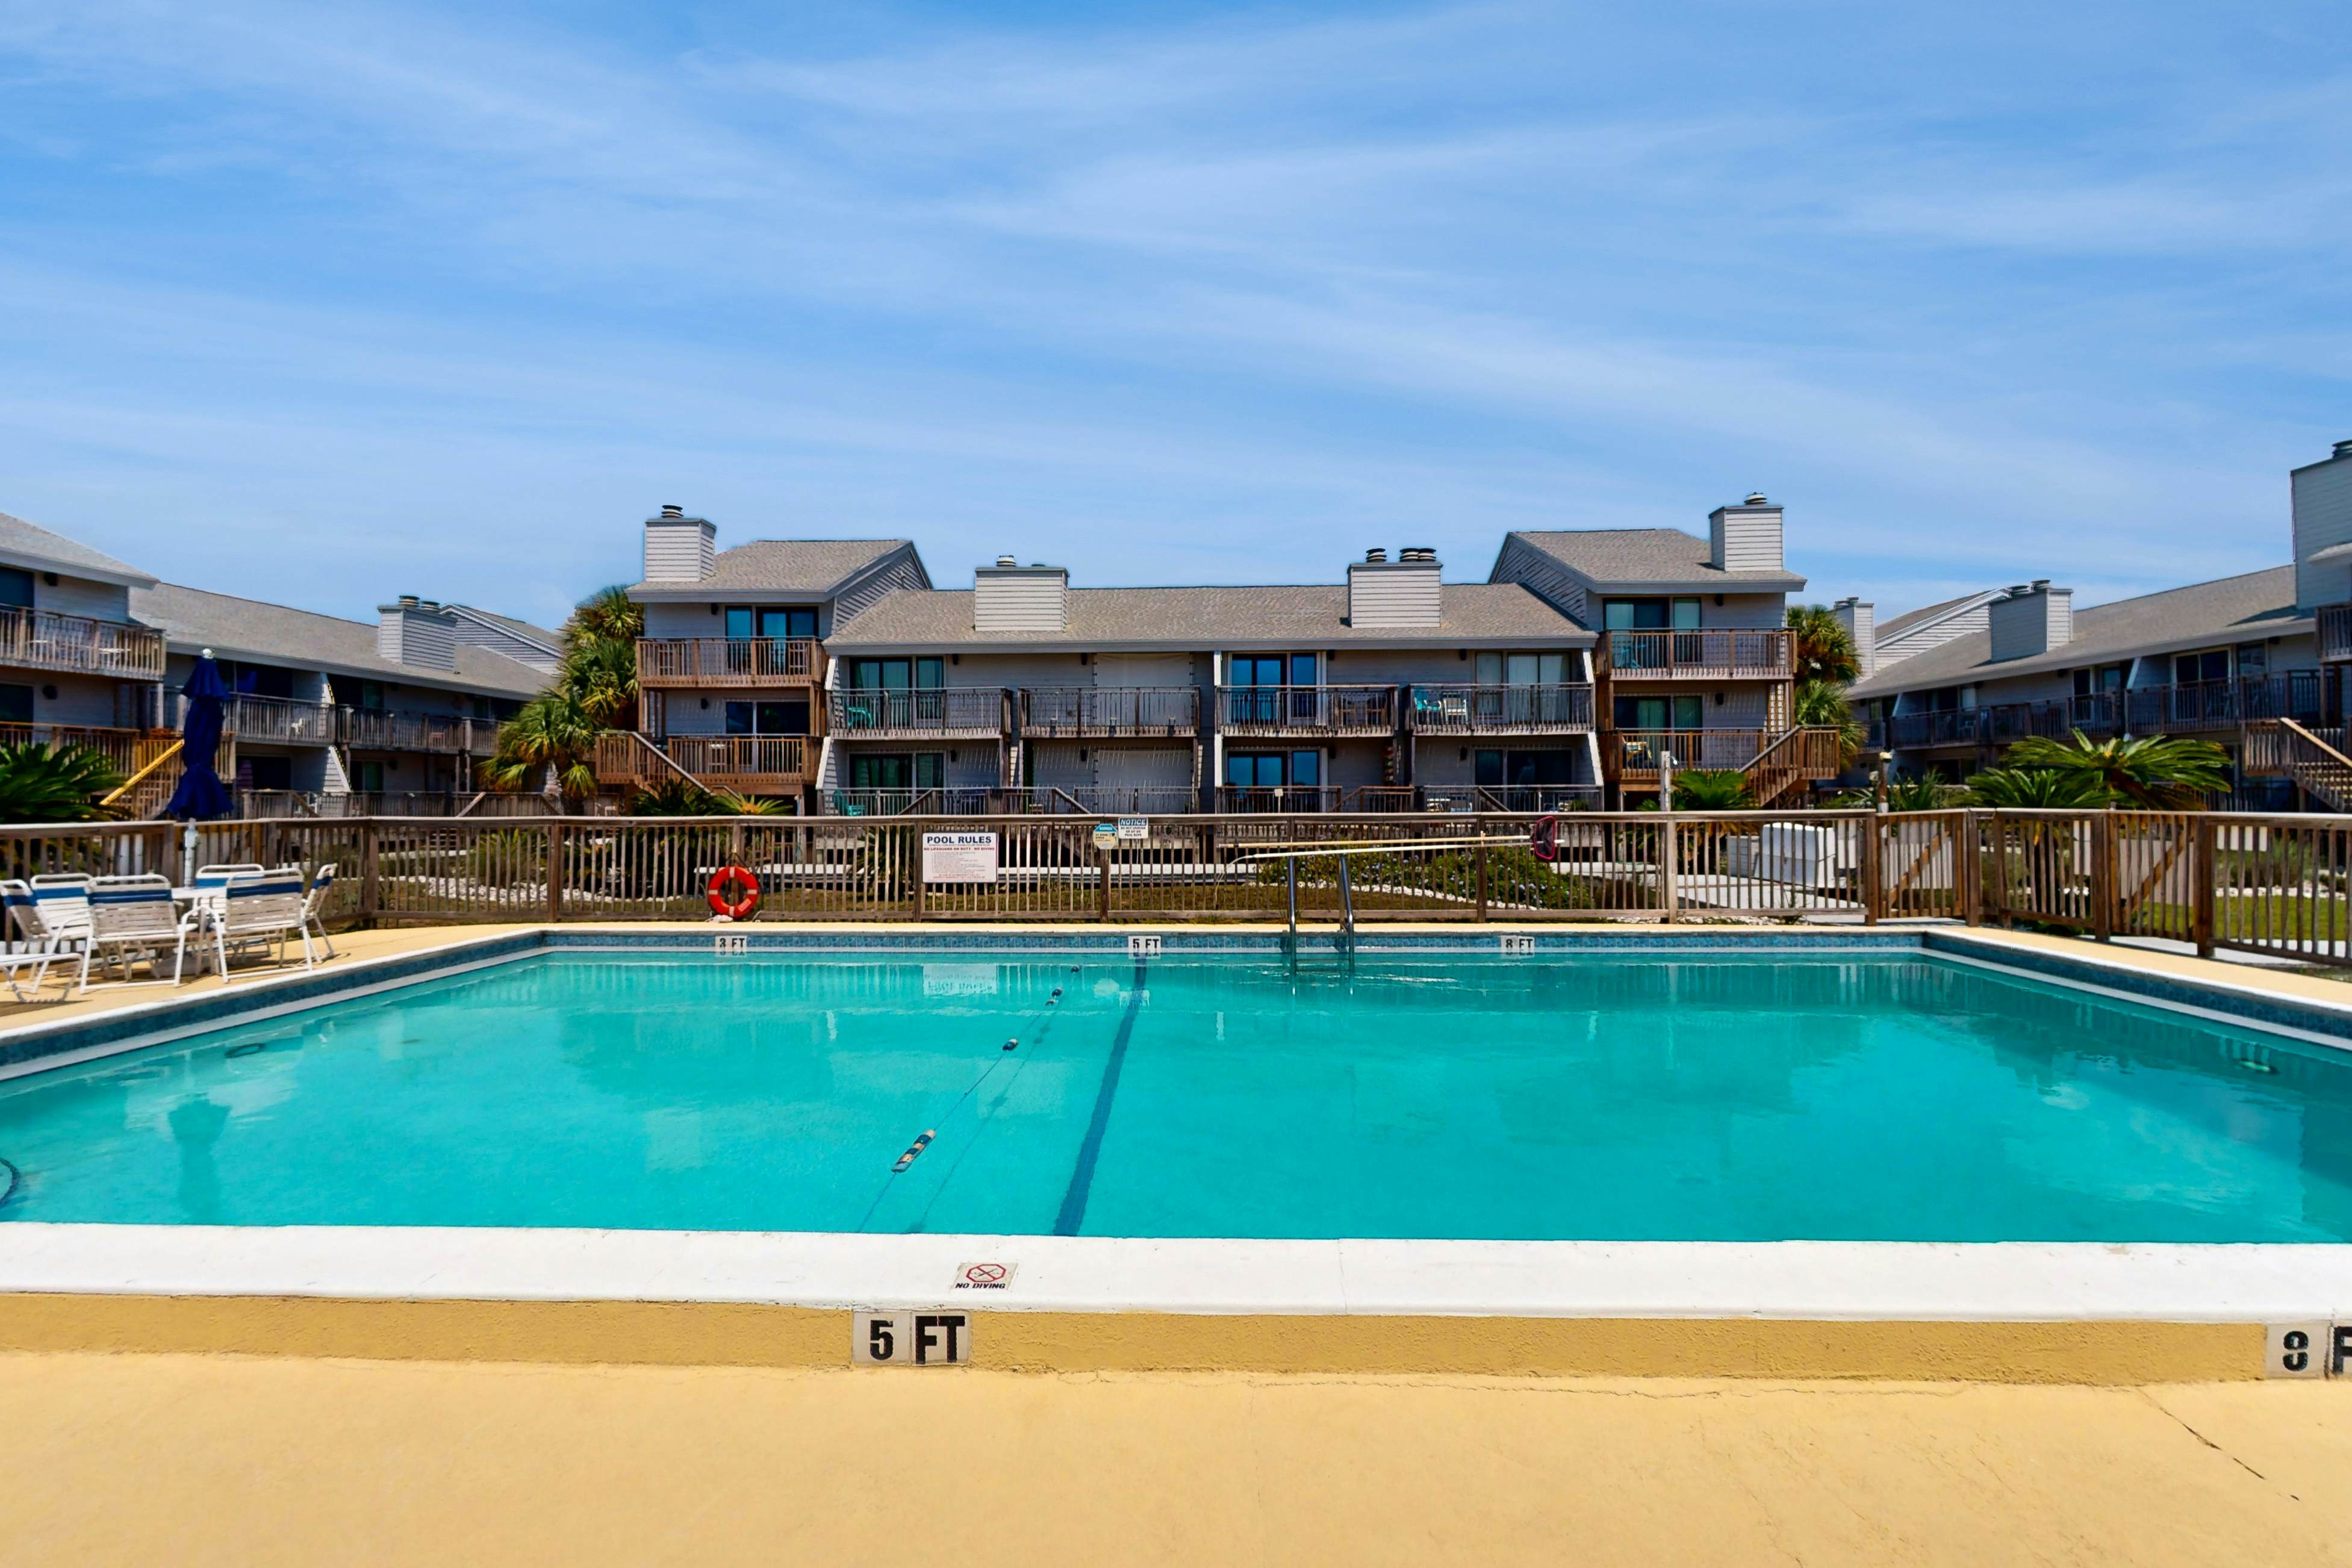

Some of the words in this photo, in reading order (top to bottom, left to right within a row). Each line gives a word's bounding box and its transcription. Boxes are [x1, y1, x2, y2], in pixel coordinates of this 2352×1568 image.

[720, 938, 726, 949] 3
[732, 938, 745, 949] FT
[1133, 938, 1140, 950] 5
[1145, 938, 1159, 950] FT
[1505, 938, 1513, 949] 8
[1519, 938, 1533, 949] FT
[870, 1319, 894, 1361] 5
[915, 1315, 965, 1365] FT
